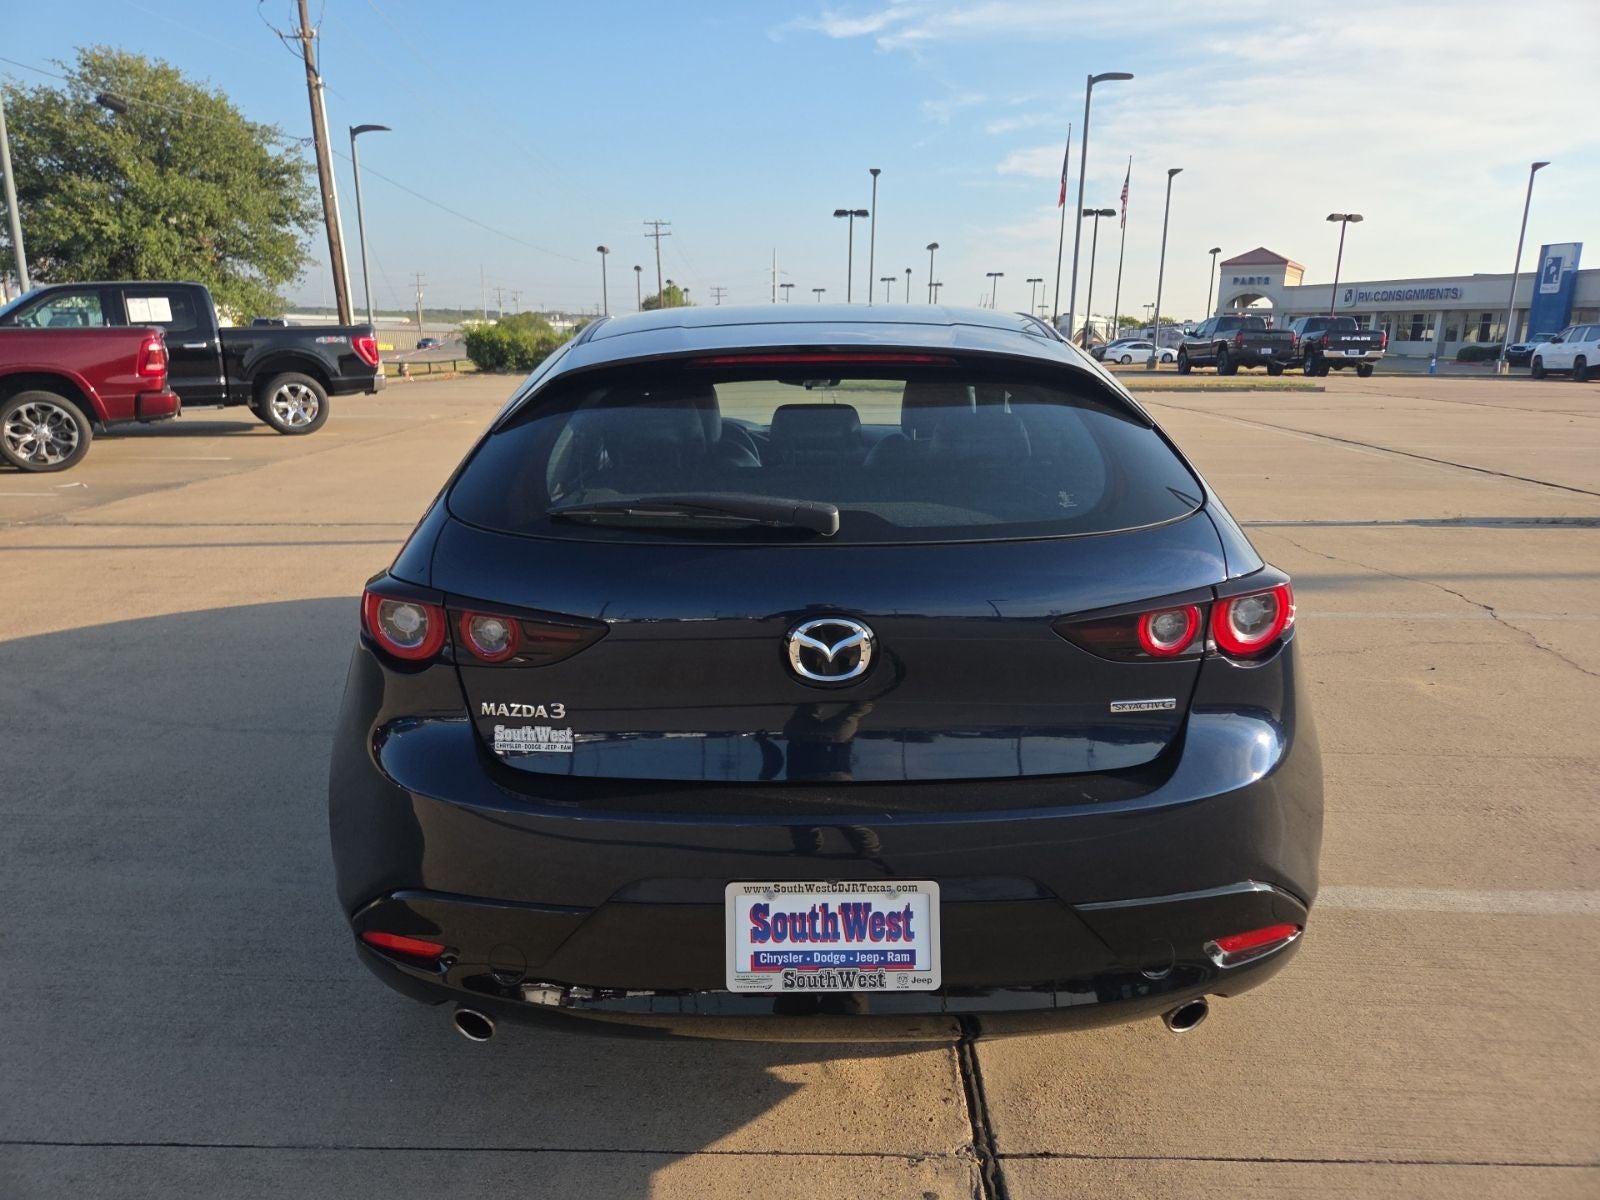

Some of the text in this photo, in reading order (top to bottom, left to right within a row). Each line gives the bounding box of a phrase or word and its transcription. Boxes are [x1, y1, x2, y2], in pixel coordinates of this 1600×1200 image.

[1233, 276, 1270, 286] PARTS
[1374, 288, 1460, 302] CONSIGNMENTS
[494, 724, 573, 742] SouthWest
[750, 902, 915, 944] SouthWest
[760, 951, 910, 965] Chrysler Dodge Jeep Ram
[783, 970, 886, 989] SouthWest
[911, 976, 932, 984] Jeep
